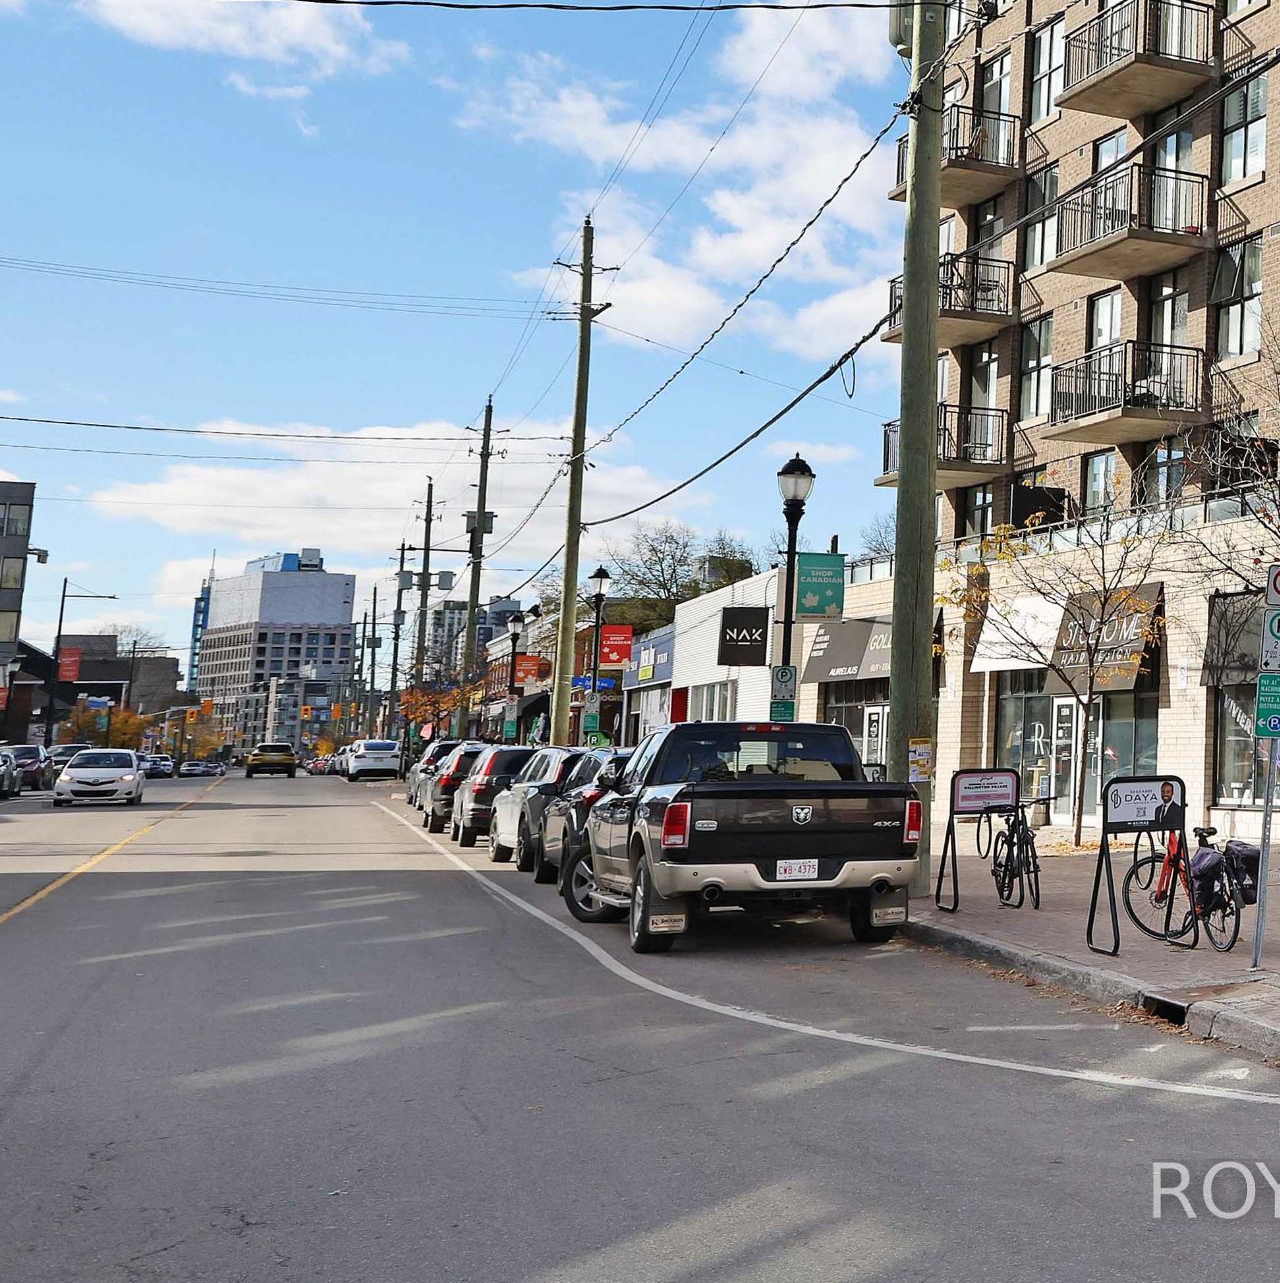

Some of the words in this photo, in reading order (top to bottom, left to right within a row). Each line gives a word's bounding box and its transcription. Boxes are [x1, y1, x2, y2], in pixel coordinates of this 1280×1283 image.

[800, 576, 843, 584] CANADIAN
[726, 628, 763, 641] NAK
[1273, 641, 1279, 650] 2
[1060, 652, 1086, 666] HAIR
[828, 666, 859, 676] AURELIUS
[1125, 793, 1158, 802] DAYA
